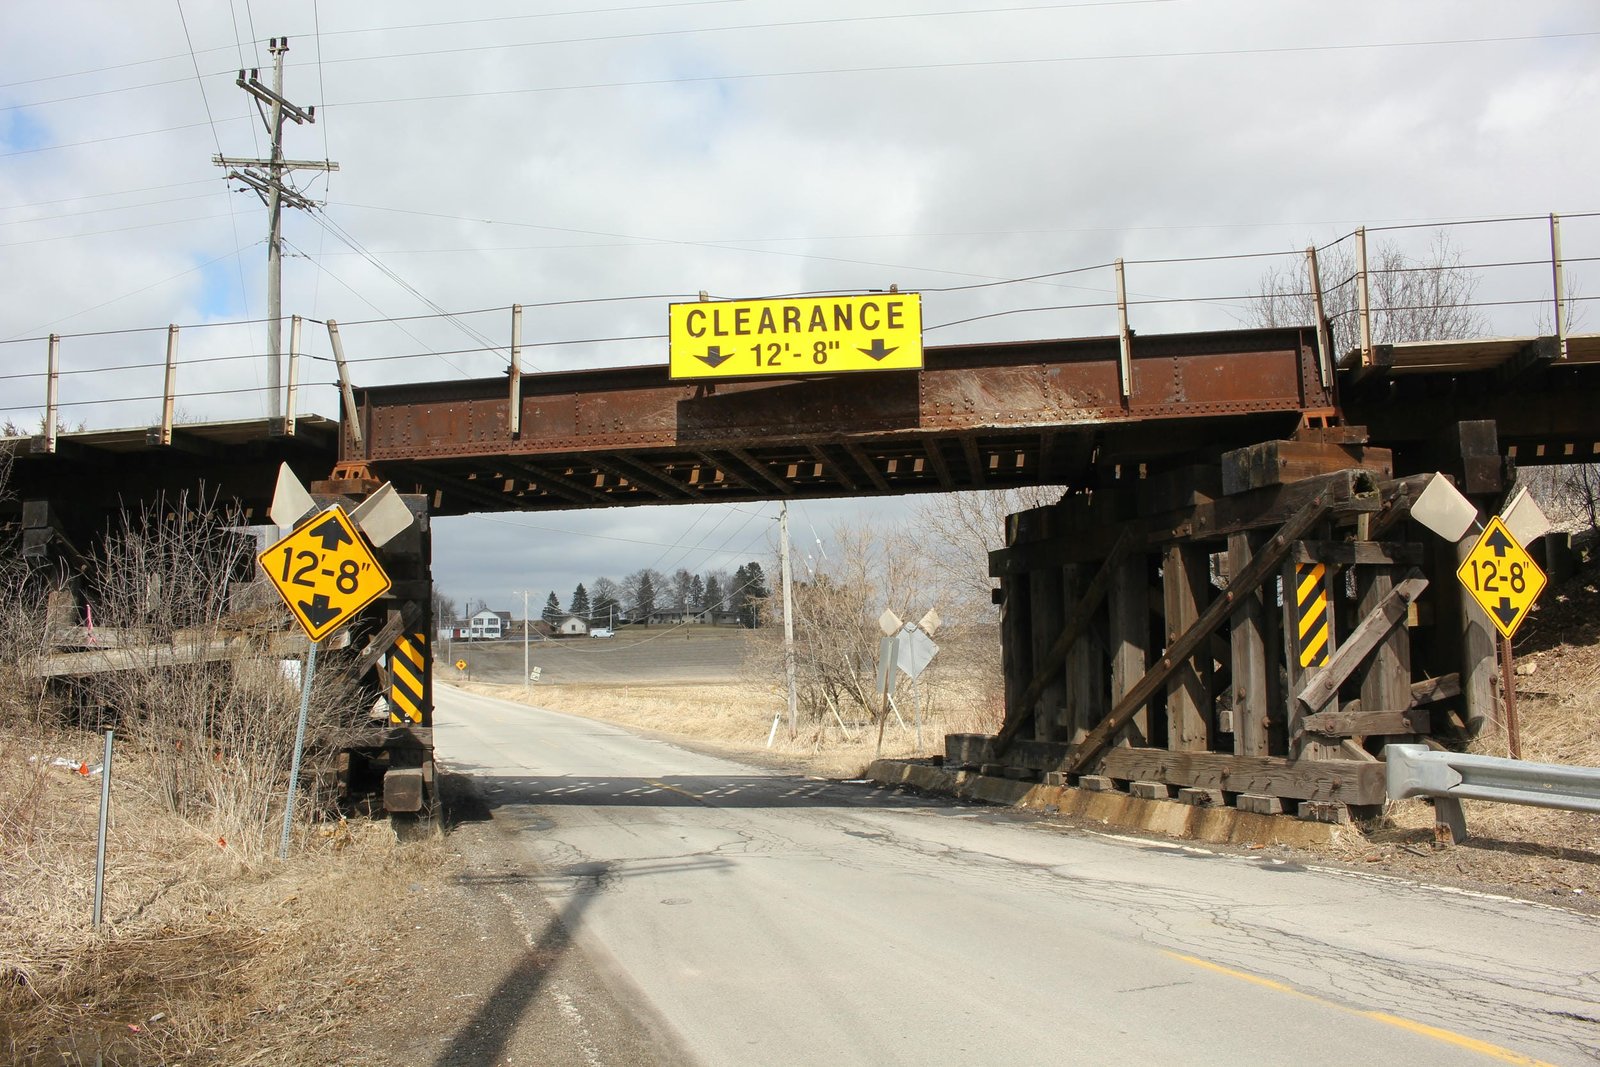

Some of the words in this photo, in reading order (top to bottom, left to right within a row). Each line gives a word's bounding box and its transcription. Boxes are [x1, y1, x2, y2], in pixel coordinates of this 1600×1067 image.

[686, 302, 904, 338] CLEARANCE
[281, 547, 371, 595] 12'-8"
[1471, 560, 1529, 594] 12'-8"
